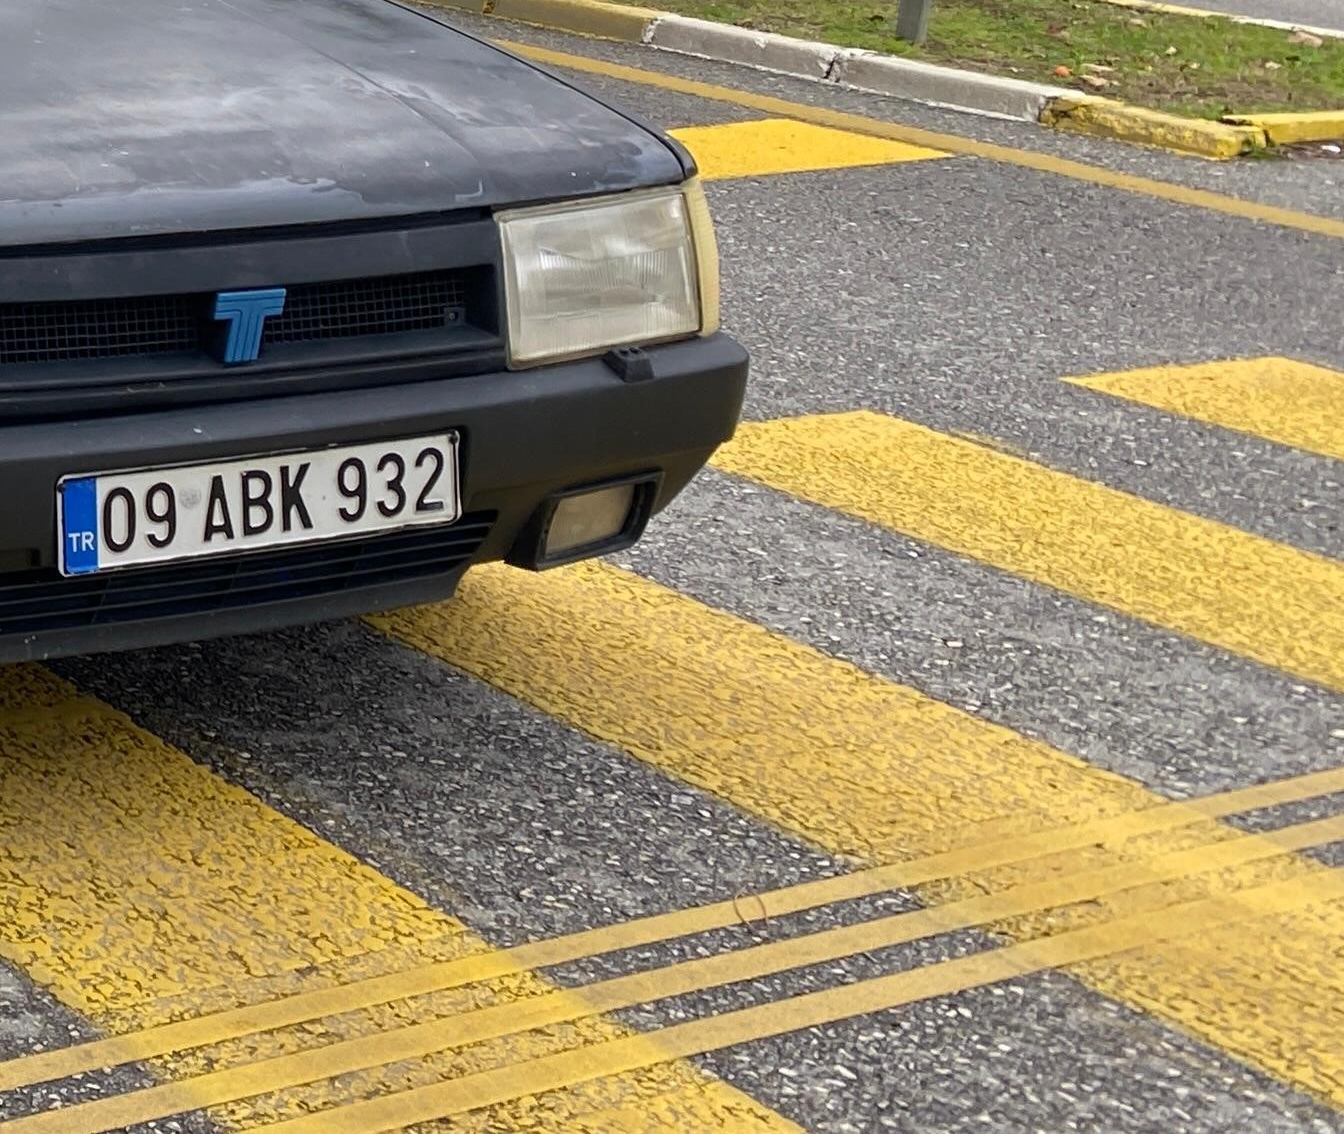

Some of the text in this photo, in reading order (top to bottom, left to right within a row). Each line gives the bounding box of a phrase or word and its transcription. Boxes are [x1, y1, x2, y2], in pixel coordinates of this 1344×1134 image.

[69, 447, 445, 553] TR 09 ABK 932
